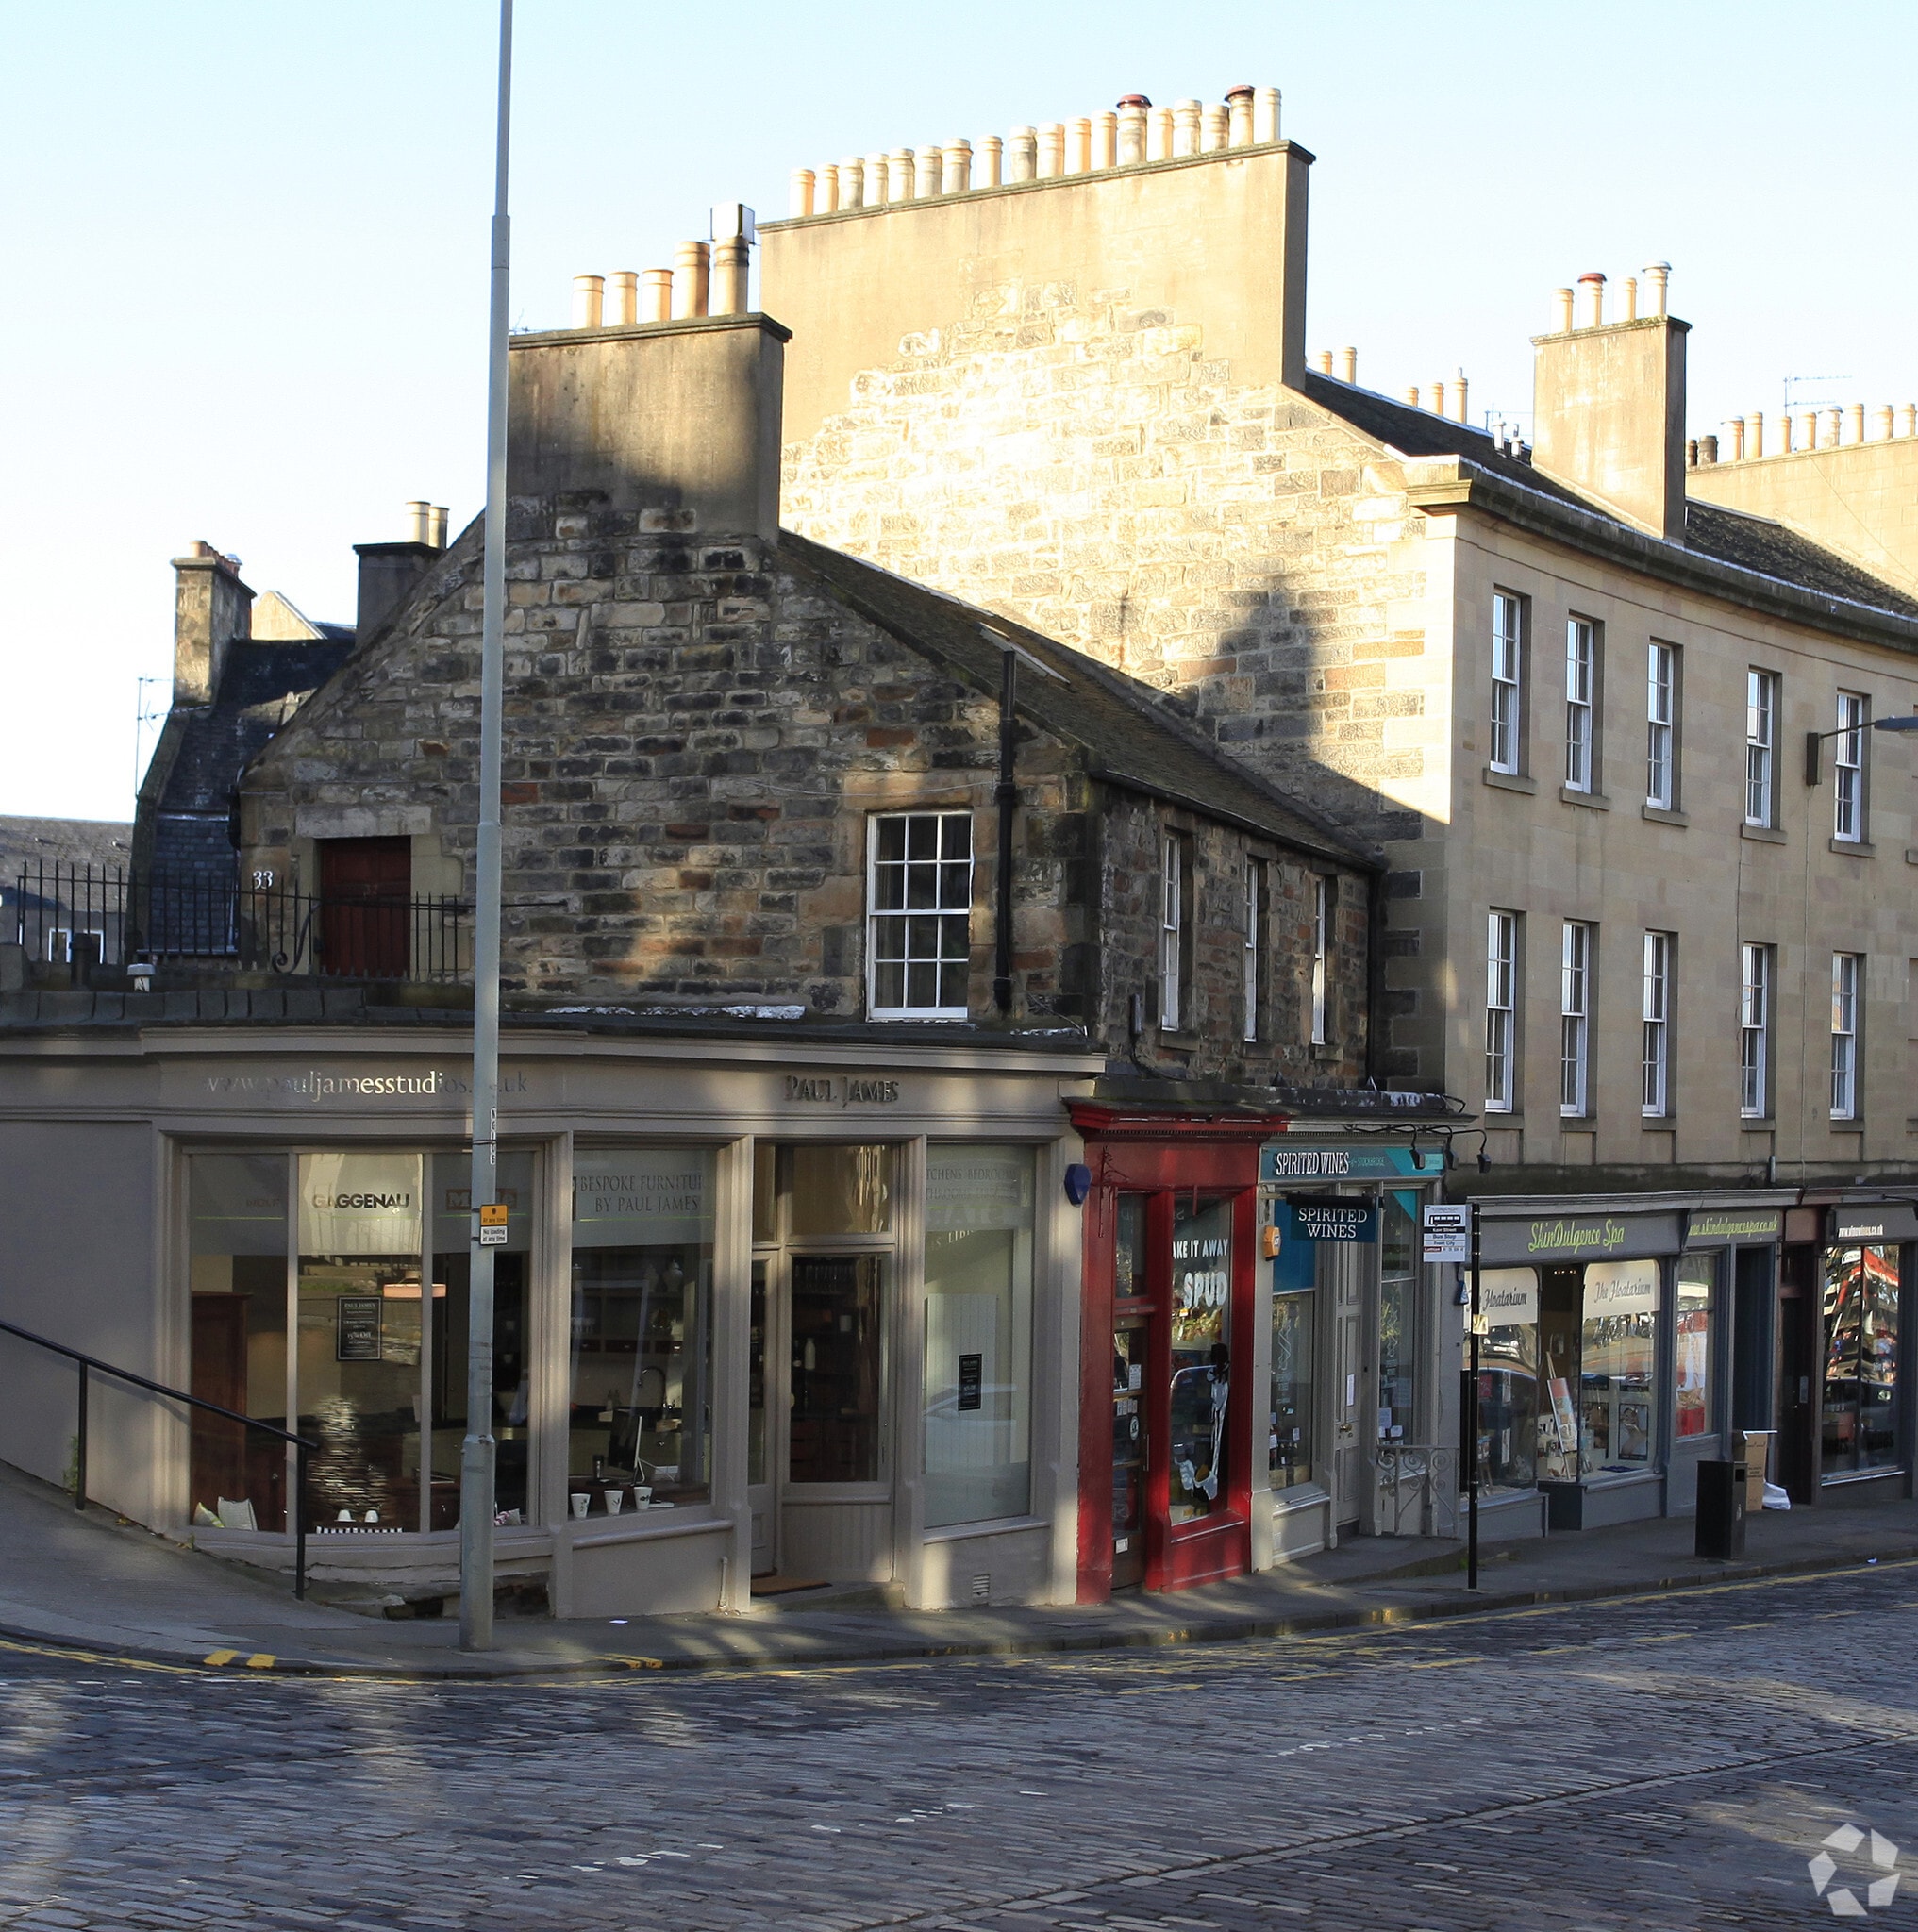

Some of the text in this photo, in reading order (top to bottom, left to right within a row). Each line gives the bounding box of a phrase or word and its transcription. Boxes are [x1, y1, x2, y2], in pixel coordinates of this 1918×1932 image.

[253, 870, 273, 890] 33
[206, 1070, 527, 1102] www.pauljamesstudios..uk
[784, 1075, 899, 1108] PAUL JAMES
[1276, 1151, 1350, 1175] SPIRITED WINES
[580, 1175, 635, 1191] BESPOKE
[312, 1193, 409, 1209] GAGGENAU
[595, 1195, 700, 1213] BY PAUL JAMES
[1298, 1208, 1368, 1223] SPIRITED
[1307, 1224, 1357, 1239] WINES
[1528, 1219, 1625, 1254] SkinDulgence Spa
[1190, 1240, 1199, 1257] IT
[1203, 1239, 1228, 1257] AWAY
[1183, 1271, 1227, 1309] SPUD
[1482, 1287, 1527, 1311] Floatarium
[1594, 1282, 1608, 1303] The
